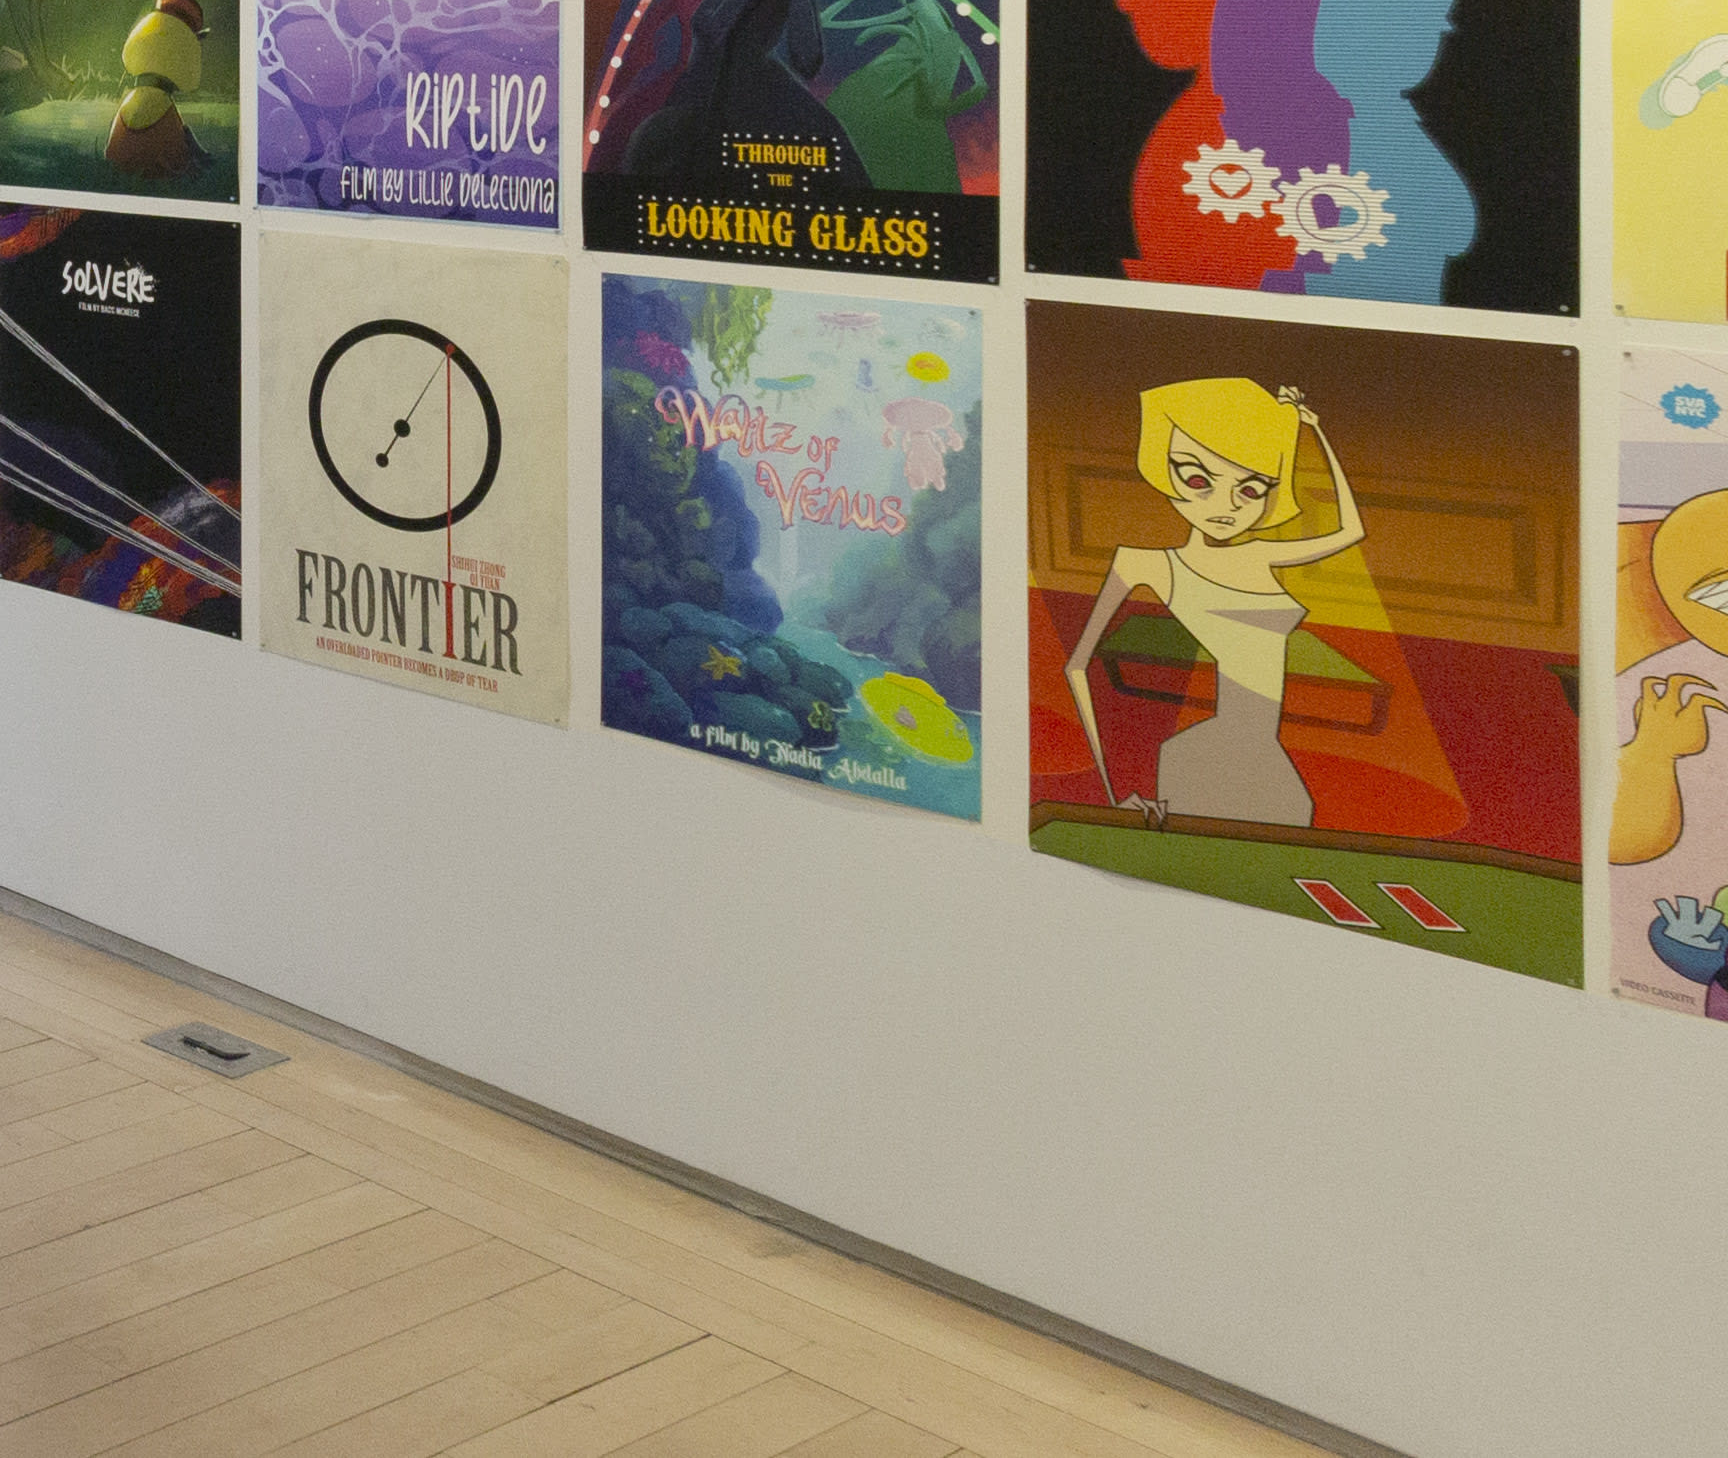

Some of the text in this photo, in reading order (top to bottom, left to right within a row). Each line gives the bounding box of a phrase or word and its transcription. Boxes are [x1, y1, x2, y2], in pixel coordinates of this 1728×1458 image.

[732, 142, 828, 168] THROUGH
[767, 171, 794, 188] THE
[646, 200, 929, 258] LOOKING GLASS
[62, 260, 155, 303] SOLVERE
[480, 558, 506, 580] ZHONG
[296, 548, 523, 677] FRONTIER
[316, 636, 326, 649] AN
[326, 638, 370, 661] OVERLOADED
[371, 649, 403, 669] POINTER
[404, 656, 437, 679] BECOMES
[438, 664, 443, 679] A
[466, 672, 477, 687] OF
[690, 724, 908, 791] a film by Nadia Abdalla
